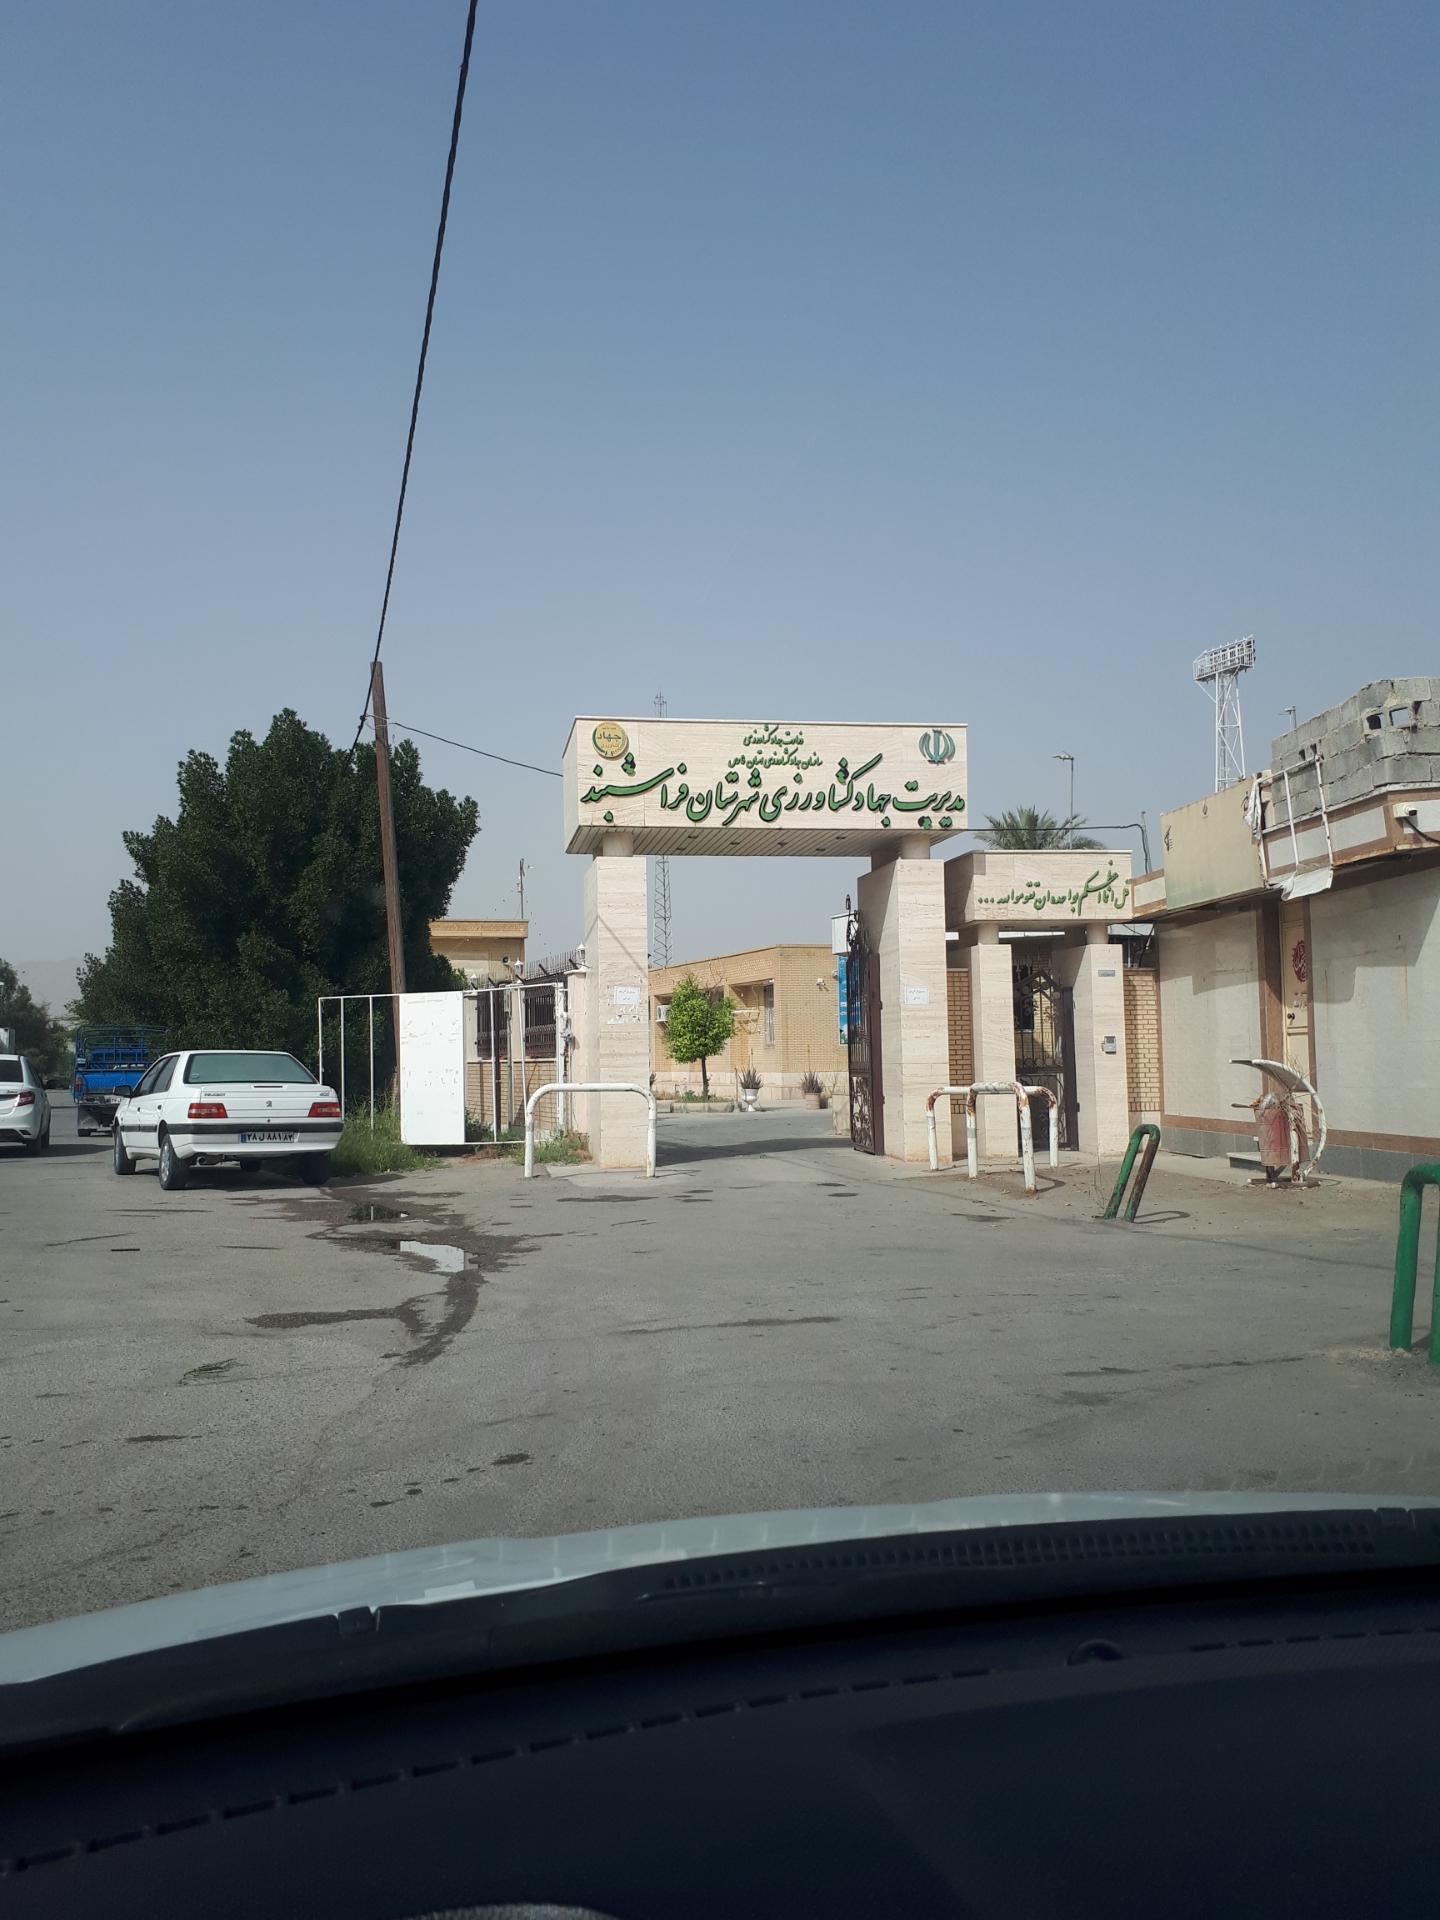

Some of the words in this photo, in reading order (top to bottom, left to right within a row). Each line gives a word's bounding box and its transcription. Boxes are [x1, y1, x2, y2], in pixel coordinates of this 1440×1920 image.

[580, 752, 690, 823] فراشبند
[686, 767, 760, 826] شهرستان
[758, 753, 882, 822] کشاورزی
[852, 782, 891, 828] جهاد
[892, 780, 965, 829] مدیریت
